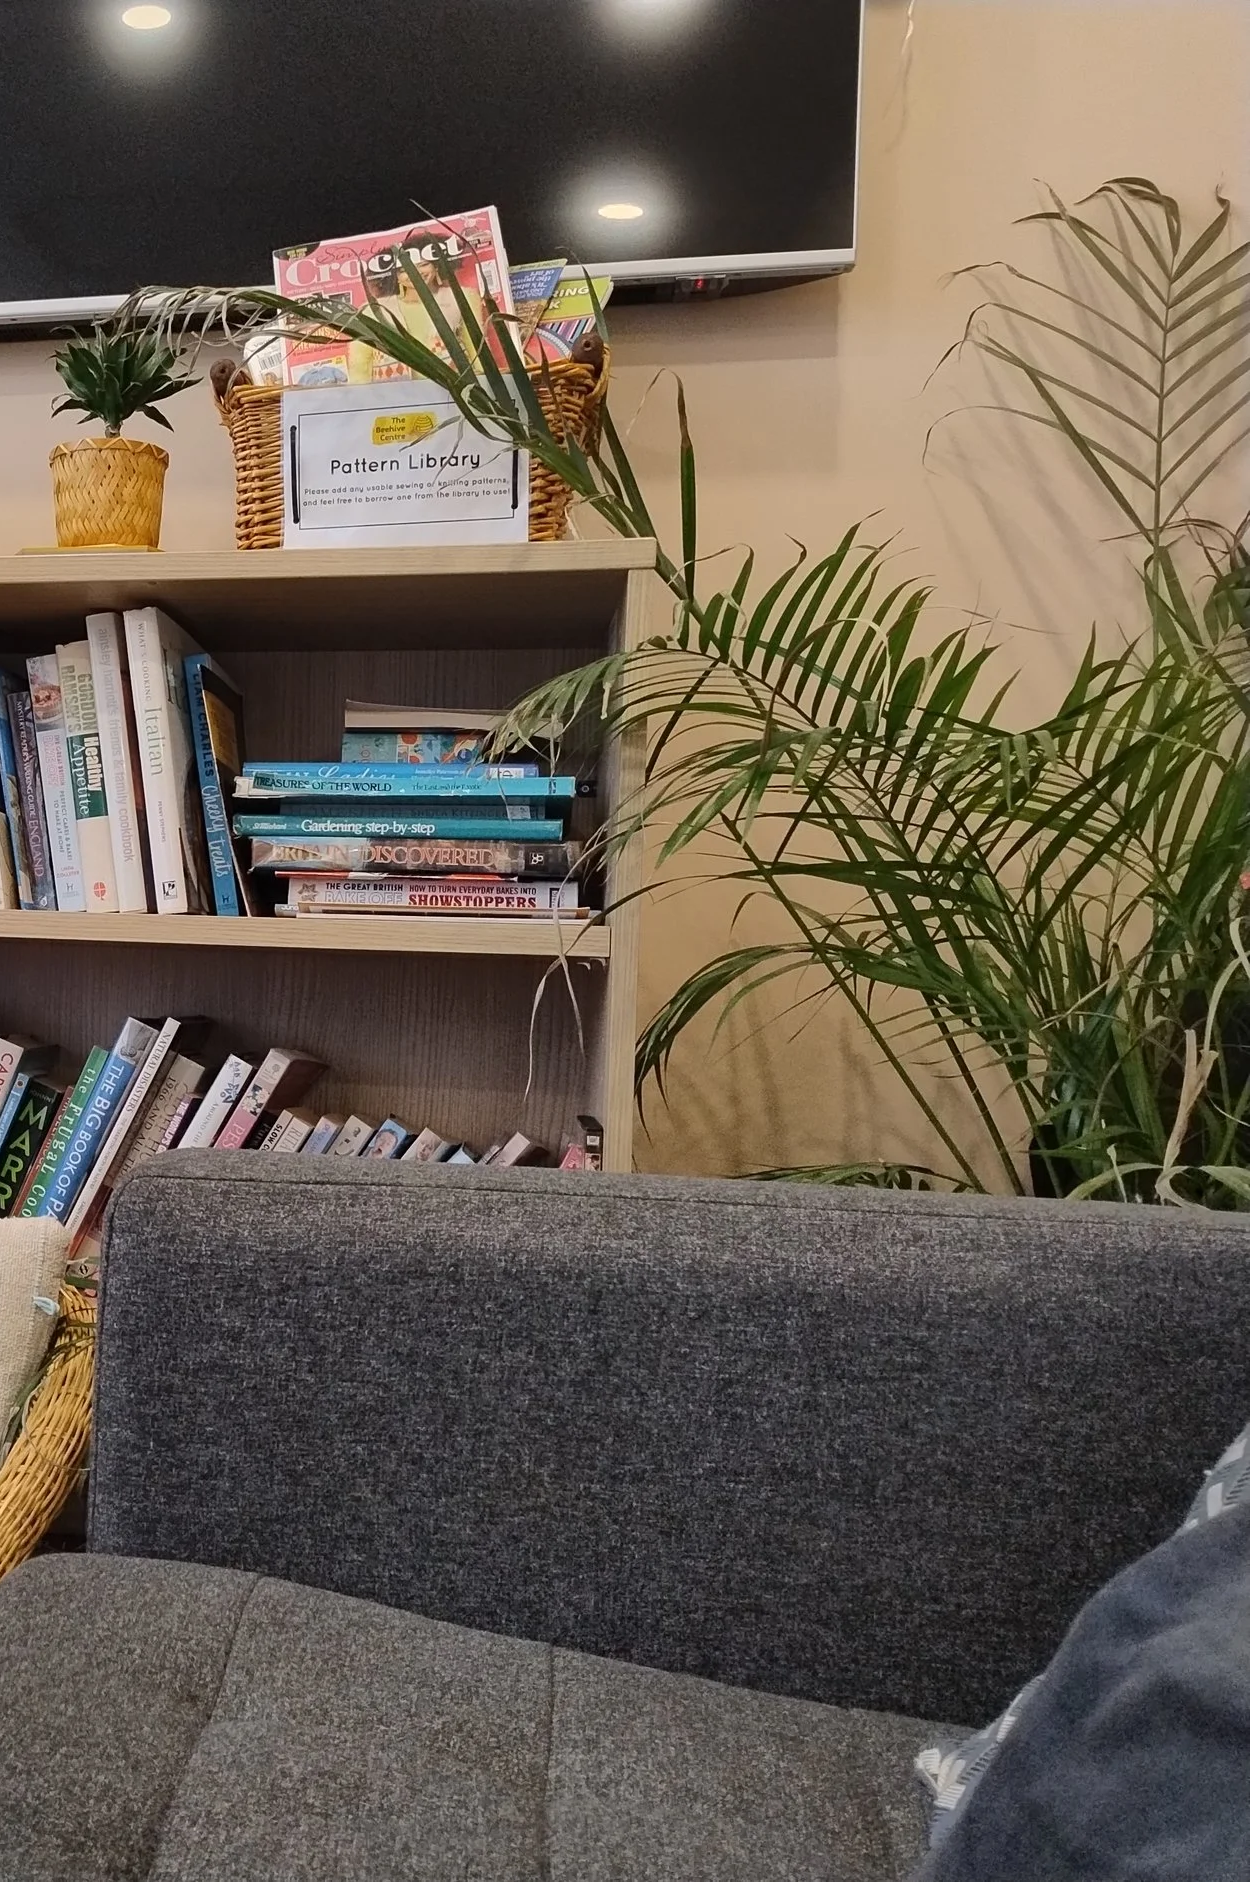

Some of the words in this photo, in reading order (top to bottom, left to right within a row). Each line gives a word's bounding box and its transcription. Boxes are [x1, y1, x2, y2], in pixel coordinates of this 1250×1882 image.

[375, 425, 406, 433] Beehive
[379, 433, 406, 441] Centre
[331, 457, 400, 475] Pattern
[409, 453, 480, 470] Library
[367, 483, 393, 491] usable
[396, 481, 424, 490] sewing
[98, 628, 112, 666] ainsley
[140, 659, 151, 701] COOKING
[194, 671, 206, 706] LIAM
[61, 664, 81, 733] RAMSAY'S
[77, 673, 97, 731] GORDON
[16, 701, 25, 731] MYSTERY
[108, 719, 121, 757] friends
[143, 707, 166, 776] Italian
[197, 711, 215, 777] CHARLES
[85, 737, 101, 792] Healthy
[115, 758, 123, 769] &
[24, 764, 34, 796] WALKING
[71, 743, 90, 817] Appetite
[116, 771, 129, 805] family
[254, 775, 309, 789] TREASURES
[312, 781, 327, 790] OF
[329, 781, 350, 791] THE
[352, 782, 392, 792] WORLD
[413, 783, 424, 791] The
[461, 783, 482, 791] Exotic
[27, 796, 36, 819] GUIDE
[53, 799, 60, 809] TO
[201, 785, 225, 835] Cheeky
[119, 808, 133, 862] cookbook
[301, 820, 363, 835] Gardening
[365, 821, 436, 836] step-by-step
[29, 821, 44, 878] ENGLAND
[208, 837, 232, 877] treats
[272, 844, 350, 861] BRITAIN
[362, 846, 498, 868] DISCOVERED
[324, 891, 366, 904] BAKE
[368, 892, 403, 904] OFF
[408, 894, 536, 908] SHOWSTOPPERS
[409, 884, 427, 893] HOW
[428, 885, 437, 893] TO
[438, 885, 457, 893] TURN
[459, 886, 494, 894] EVERYDAY
[496, 886, 519, 895] BAKES
[520, 887, 537, 895] INTO
[146, 1033, 172, 1072] NATURAL
[78, 1068, 97, 1094] the
[102, 1063, 124, 1096] THE
[126, 1072, 150, 1113] DISASTERS
[159, 1076, 177, 1101] 1966
[86, 1095, 111, 1132] BIG
[144, 1104, 162, 1132] AND
[177, 1102, 189, 1113] THE
[133, 1132, 147, 1152] ALL
[161, 1112, 183, 1146] WORLD'S
[270, 1123, 283, 1142] SLOW
[280, 1126, 302, 1150] RITA
[64, 1130, 93, 1176] BOOK
[55, 1175, 72, 1199] OF
